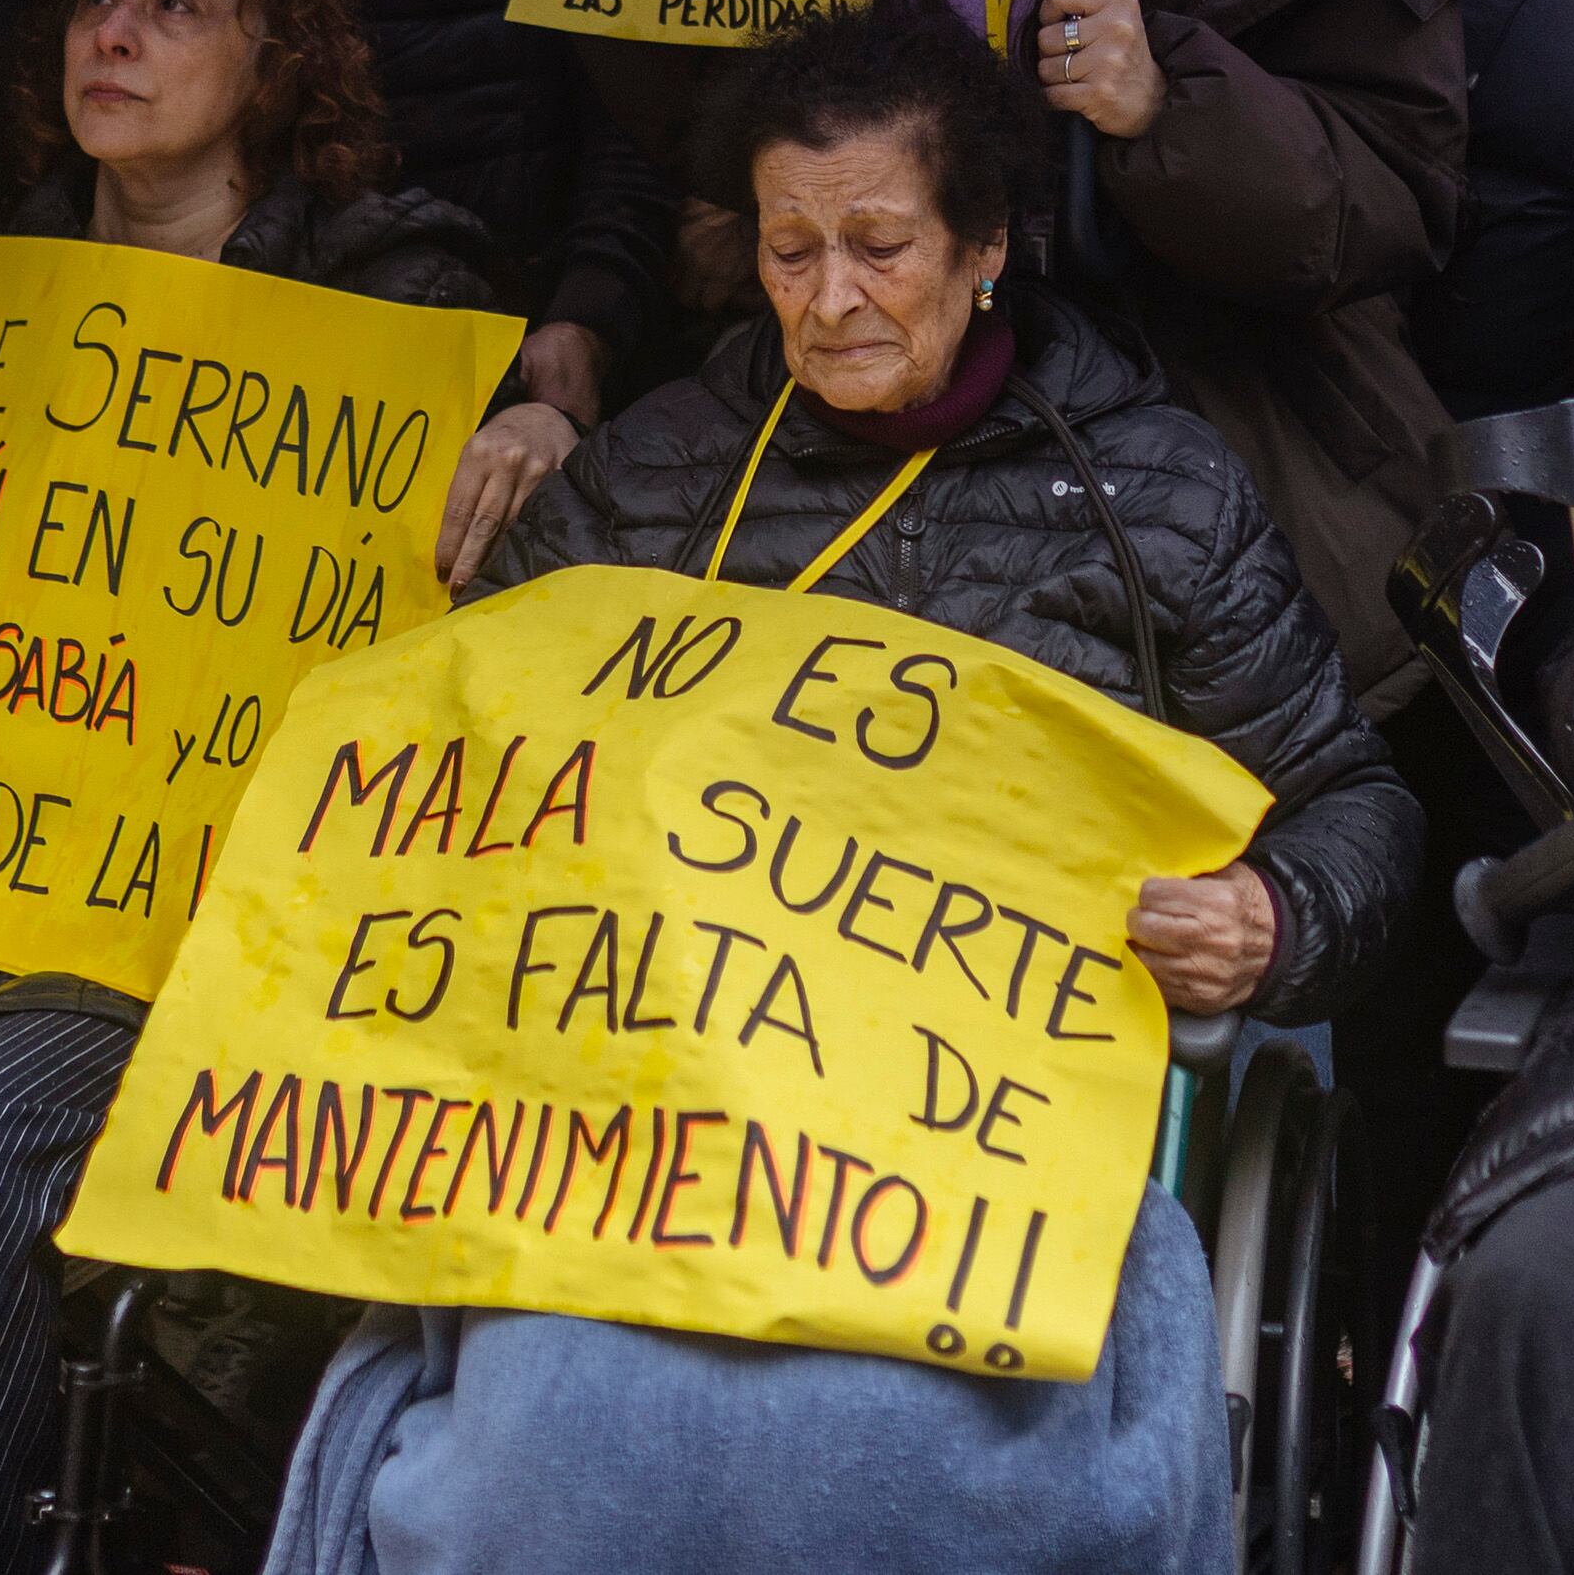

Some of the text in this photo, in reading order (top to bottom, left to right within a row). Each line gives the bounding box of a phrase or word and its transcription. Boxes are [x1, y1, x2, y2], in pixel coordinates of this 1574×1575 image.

[44, 301, 431, 515] SERRANO
[27, 480, 137, 598] EN
[162, 516, 265, 628] SU
[288, 531, 386, 652] DÍA
[580, 616, 959, 771] NO ES
[85, 814, 161, 919] LA
[297, 734, 1125, 1042] MALA SUERTE
[325, 903, 1050, 1163] ES FALTA DE
